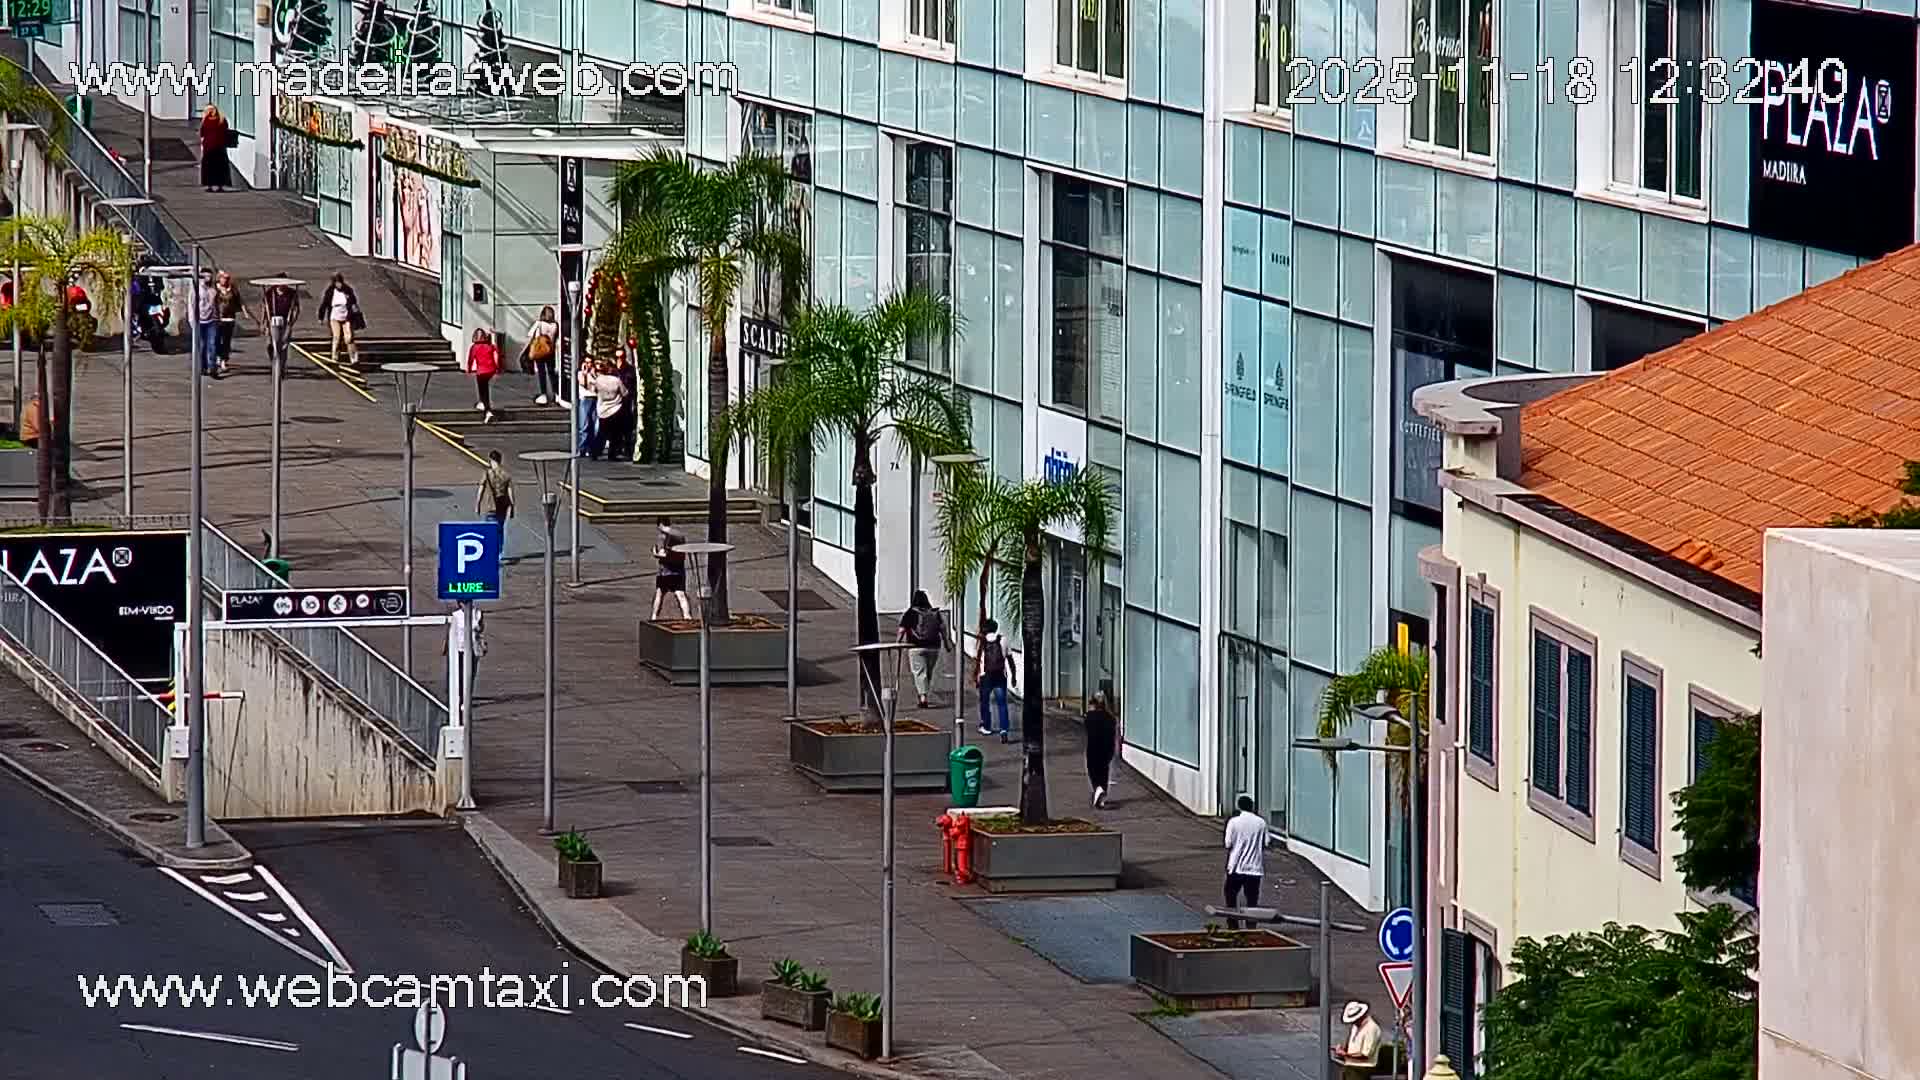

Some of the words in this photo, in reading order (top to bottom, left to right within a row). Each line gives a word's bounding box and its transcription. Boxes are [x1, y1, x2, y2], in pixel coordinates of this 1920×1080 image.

[9, 0, 50, 17] 12:29
[1763, 60, 1878, 160] PLAZA
[457, 539, 484, 574] P
[448, 582, 483, 593] LIVRE
